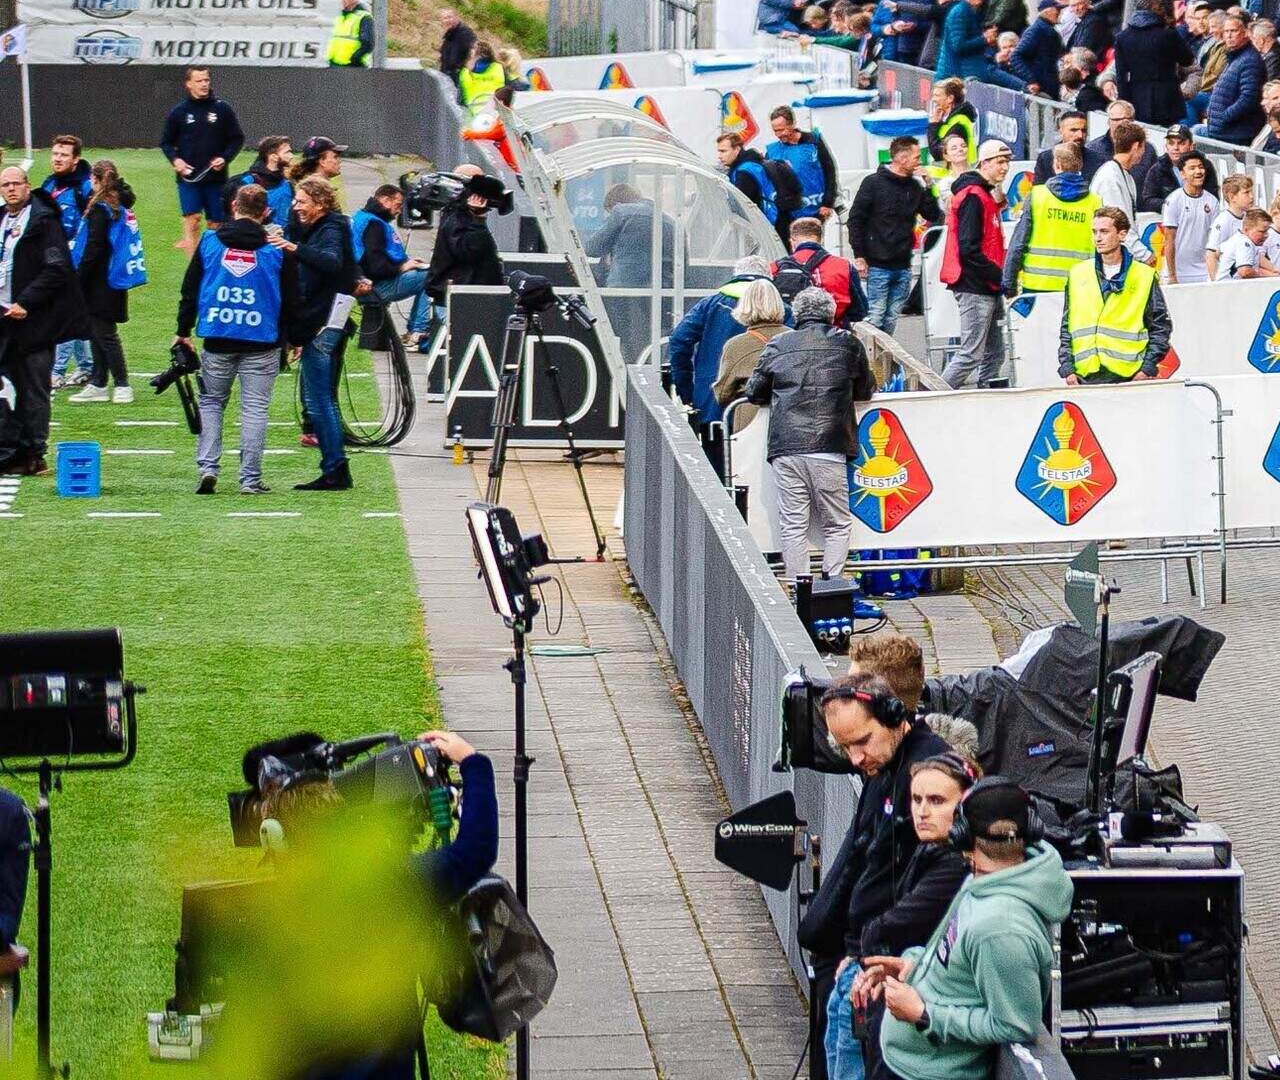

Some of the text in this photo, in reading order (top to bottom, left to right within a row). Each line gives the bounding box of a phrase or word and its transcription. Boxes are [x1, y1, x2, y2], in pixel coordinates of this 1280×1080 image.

[153, 40, 249, 58] MOTOR
[258, 40, 320, 59] OILS
[1047, 208, 1087, 223] STEWARD
[217, 286, 256, 305] 033
[207, 307, 262, 326] FOTO
[856, 473, 906, 488] TELSTAR
[1040, 465, 1090, 480] TELSTAR
